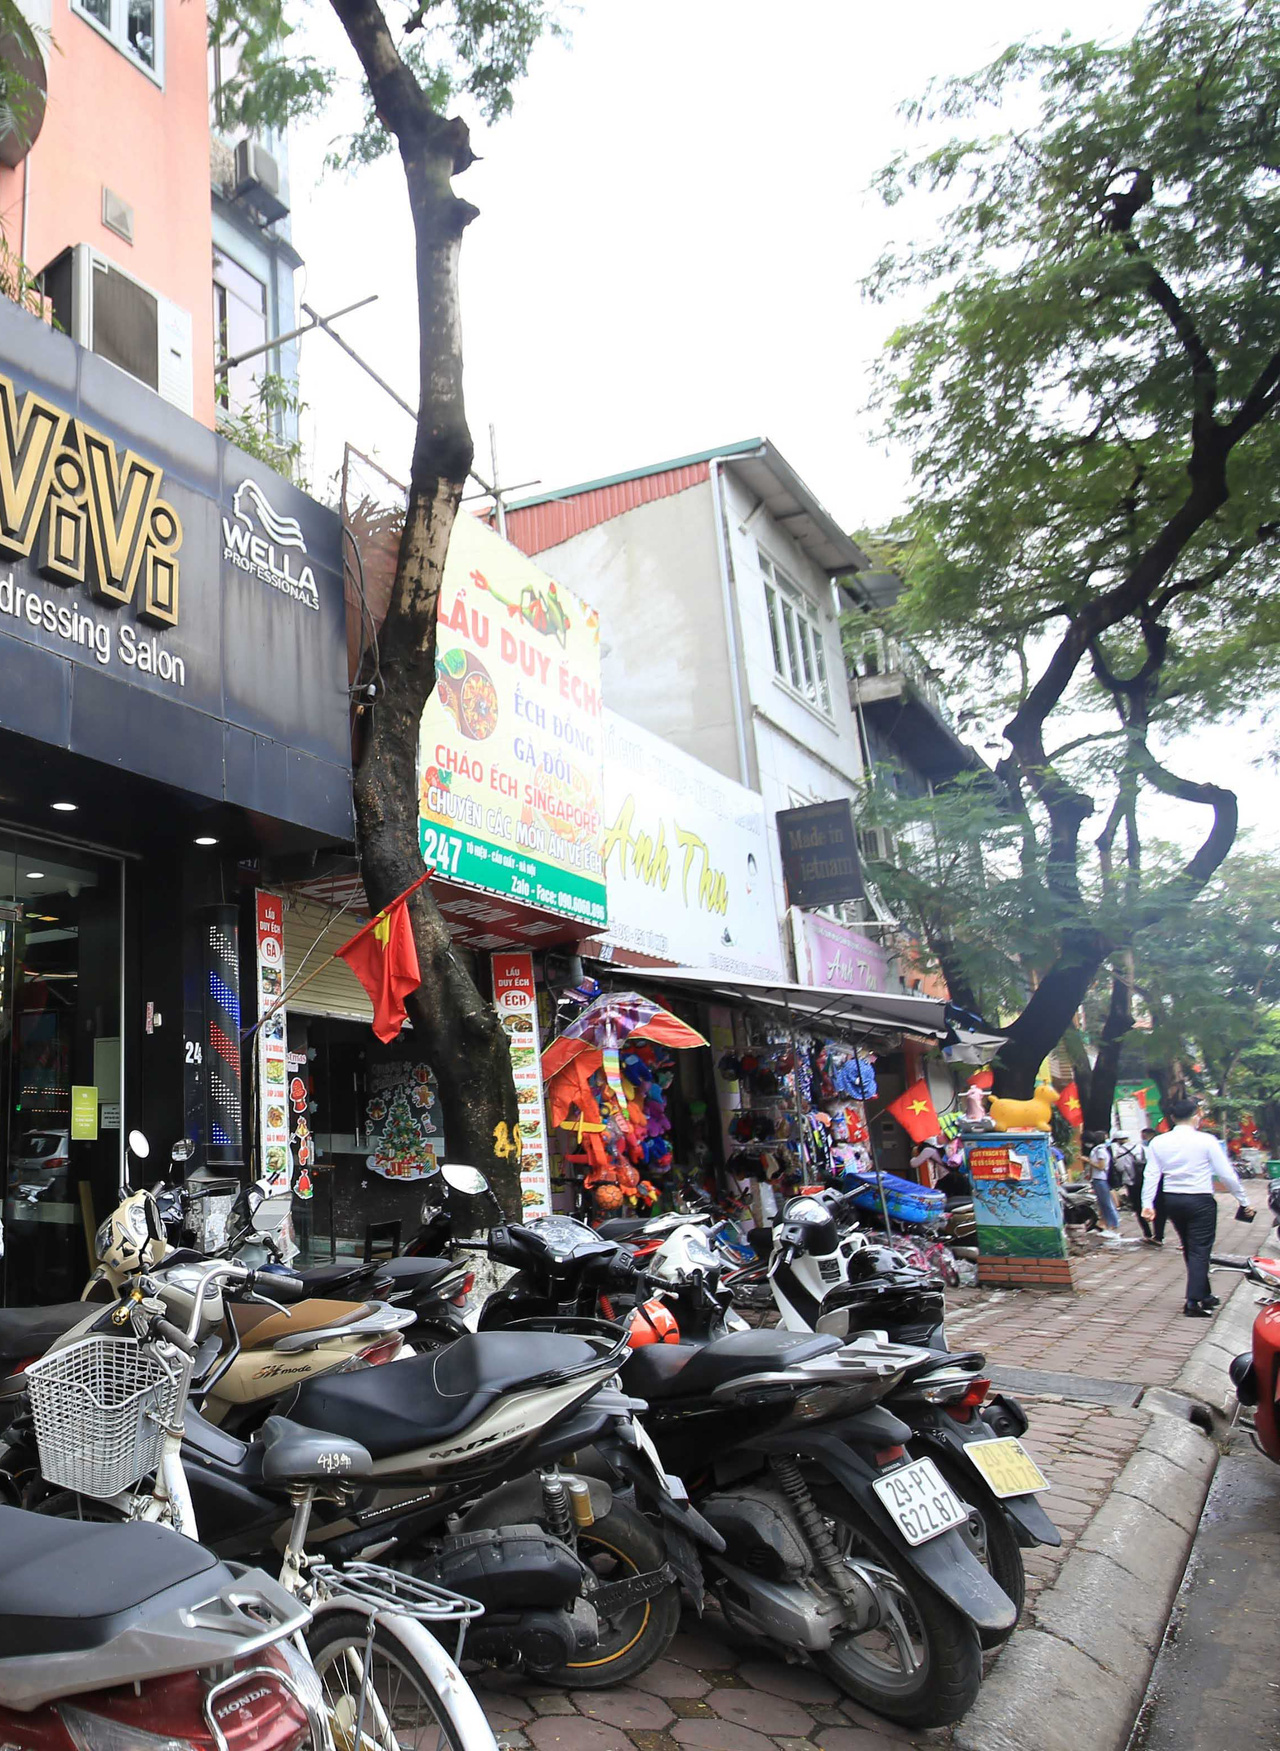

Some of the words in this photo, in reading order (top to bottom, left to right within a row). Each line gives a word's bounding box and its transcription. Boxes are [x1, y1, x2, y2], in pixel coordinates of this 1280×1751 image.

[222, 517, 319, 598] WELLA
[223, 547, 320, 611] PROFESSIONALS
[118, 624, 185, 686] Salon
[501, 627, 551, 686] DUY
[558, 660, 597, 717] ẾCH
[514, 681, 546, 730] ẾCH
[513, 737, 537, 767] GÀ
[435, 744, 484, 783] CHÁO
[490, 763, 518, 799] ẾCH
[524, 784, 598, 834] SINGAPORE
[427, 786, 483, 829] CHUYÊN
[486, 807, 512, 840] CÁC
[516, 819, 546, 850] MÓN
[424, 828, 463, 874] 247
[511, 876, 530, 897] Zalo
[536, 884, 557, 904] Face:
[266, 941, 277, 953] GÀ
[498, 979, 513, 987] DUY
[504, 992, 527, 1006] ẾCH
[185, 1041, 202, 1064] 24
[281, 1364, 312, 1375] mode
[885, 1465, 937, 1508] 29-P1
[899, 1491, 958, 1539] 622.87
[216, 1687, 272, 1719] HONDA
